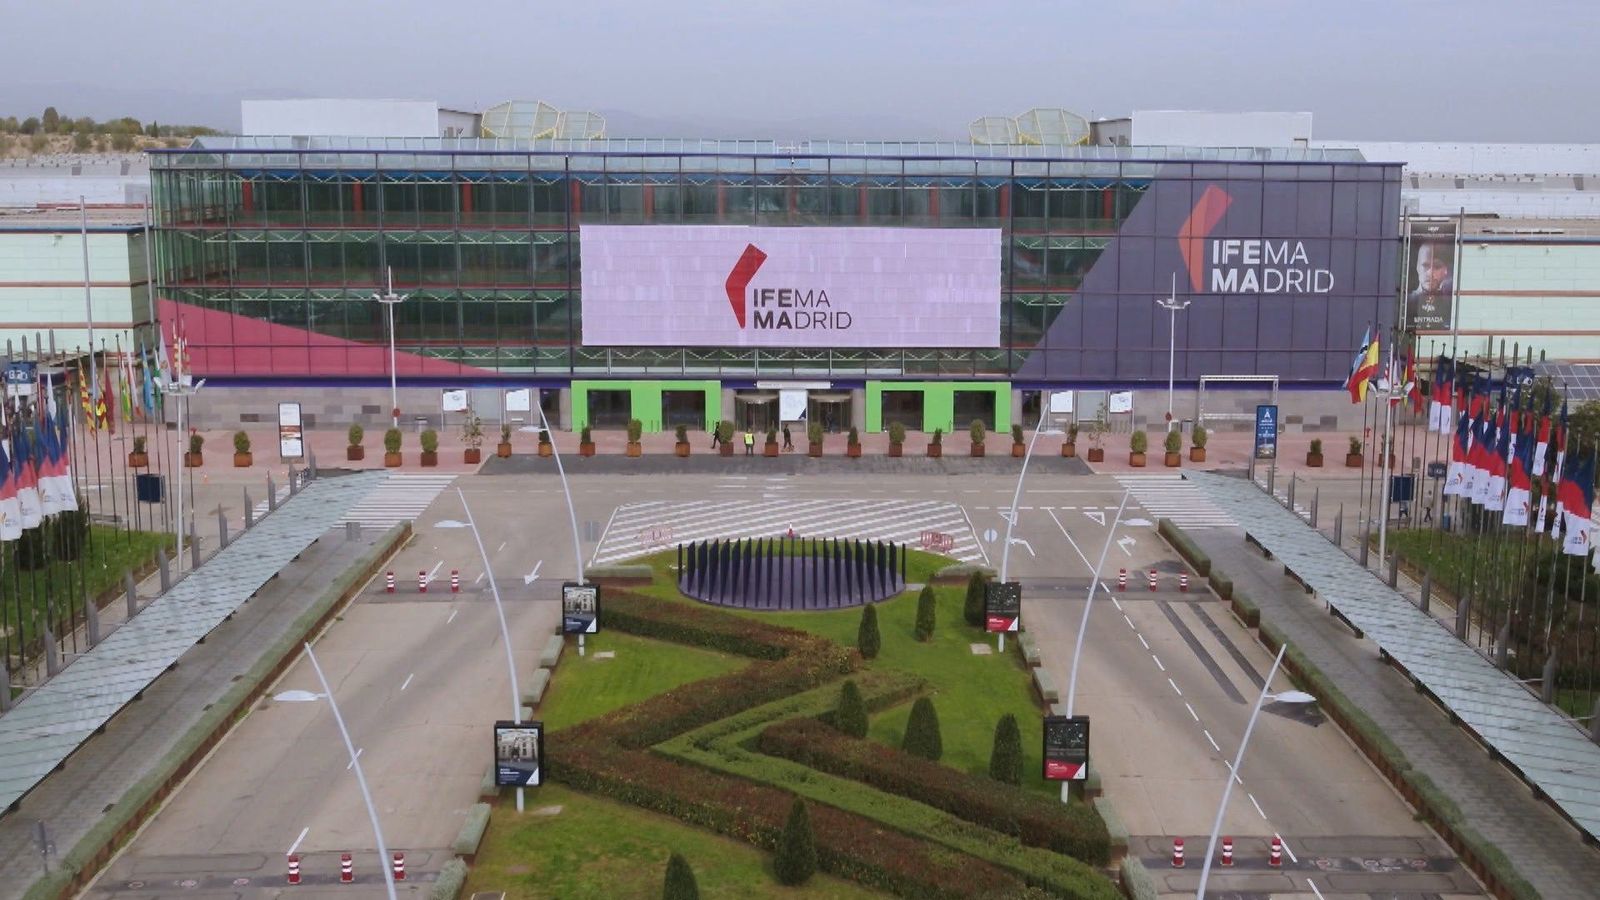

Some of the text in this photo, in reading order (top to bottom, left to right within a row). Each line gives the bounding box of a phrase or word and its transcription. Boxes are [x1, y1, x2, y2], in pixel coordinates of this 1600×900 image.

[1212, 240, 1309, 265] IFEMA
[1211, 268, 1335, 293] MADRID
[753, 288, 831, 308] IFEMA
[753, 310, 852, 330] MADRID
